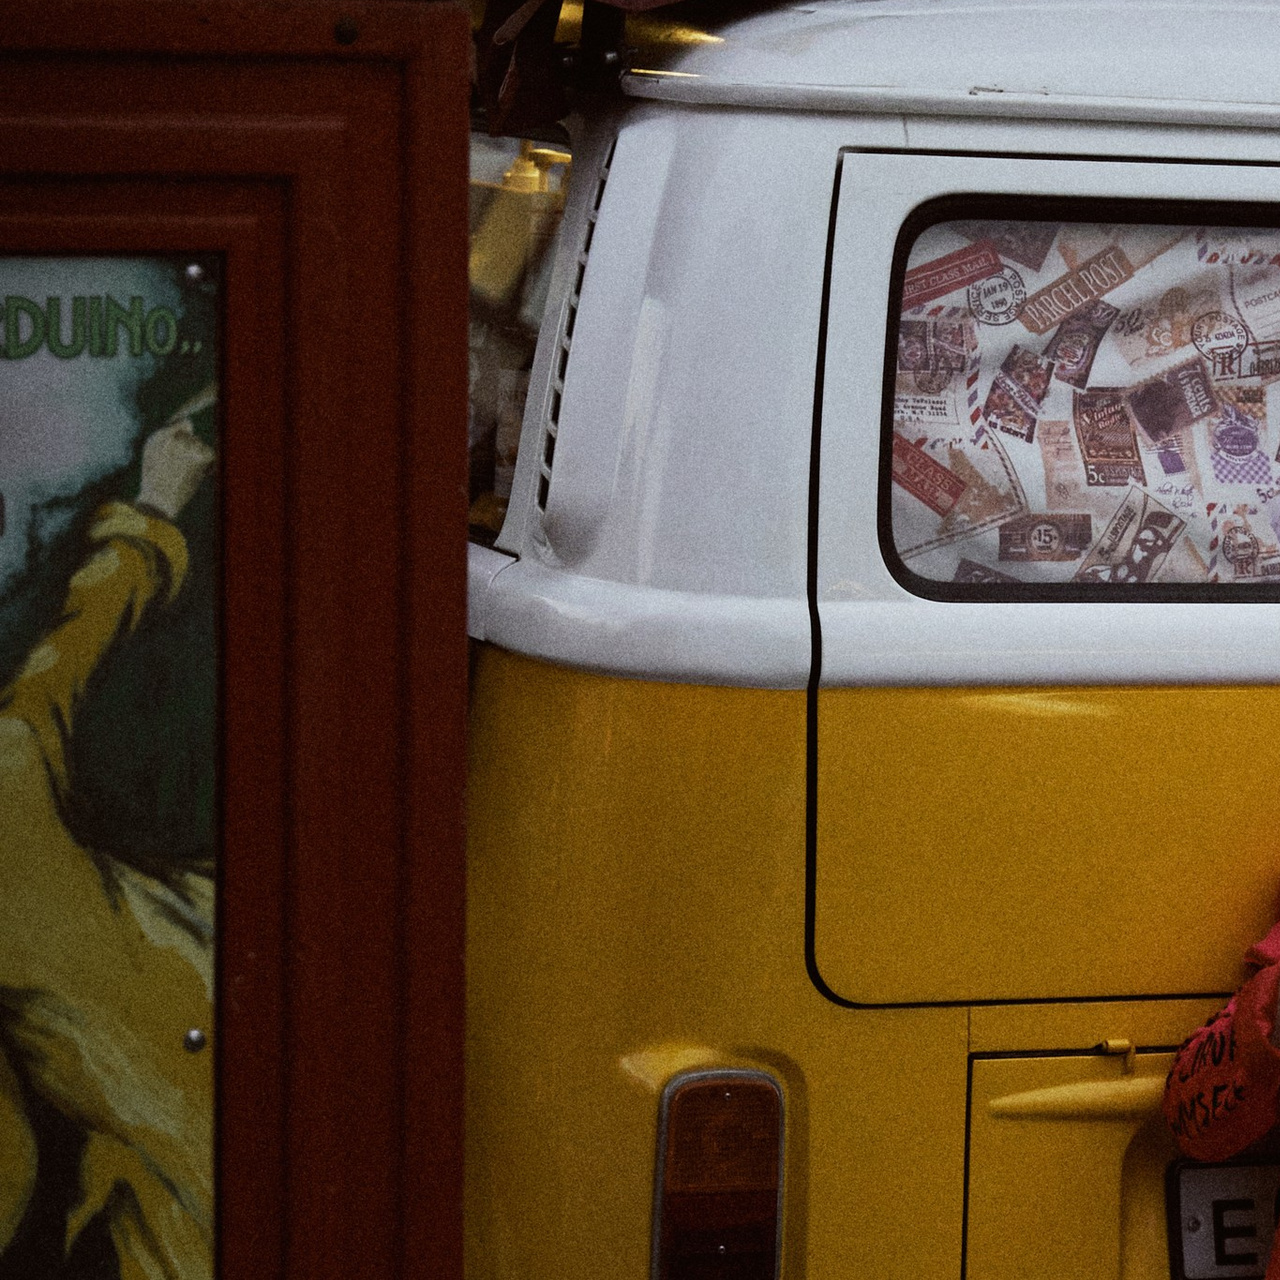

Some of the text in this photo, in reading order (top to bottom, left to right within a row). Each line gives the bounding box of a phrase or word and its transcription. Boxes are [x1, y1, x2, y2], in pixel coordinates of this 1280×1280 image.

[902, 257, 990, 297] IRST CLASS MAIL
[1025, 252, 1128, 329] PARCEL POST
[1088, 464, 1106, 483] 5c
[1036, 528, 1055, 545] 15
